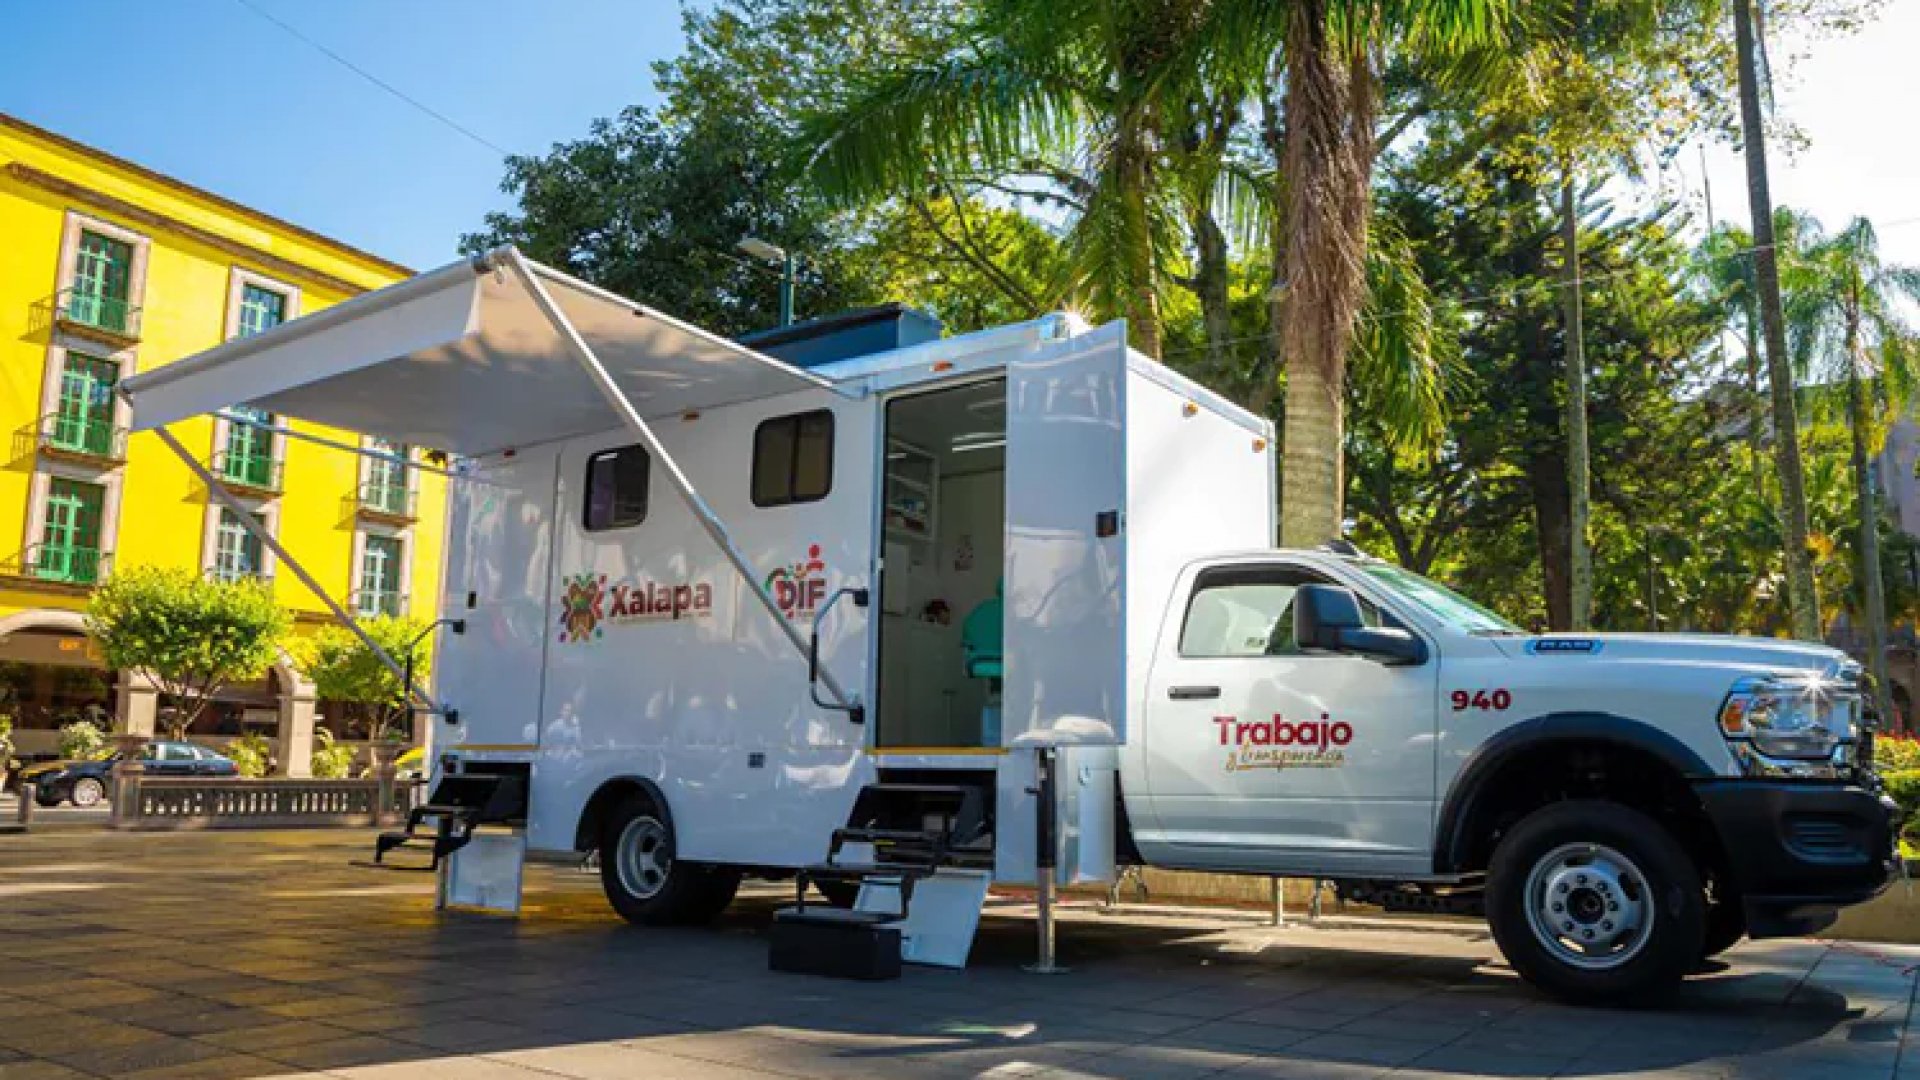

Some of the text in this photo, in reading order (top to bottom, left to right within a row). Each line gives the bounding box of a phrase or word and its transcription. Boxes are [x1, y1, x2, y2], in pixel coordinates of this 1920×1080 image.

[609, 581, 712, 619] Xalapa
[775, 579, 826, 610] DIF
[1451, 689, 1511, 711] 940
[1213, 712, 1353, 754] Trabajo
